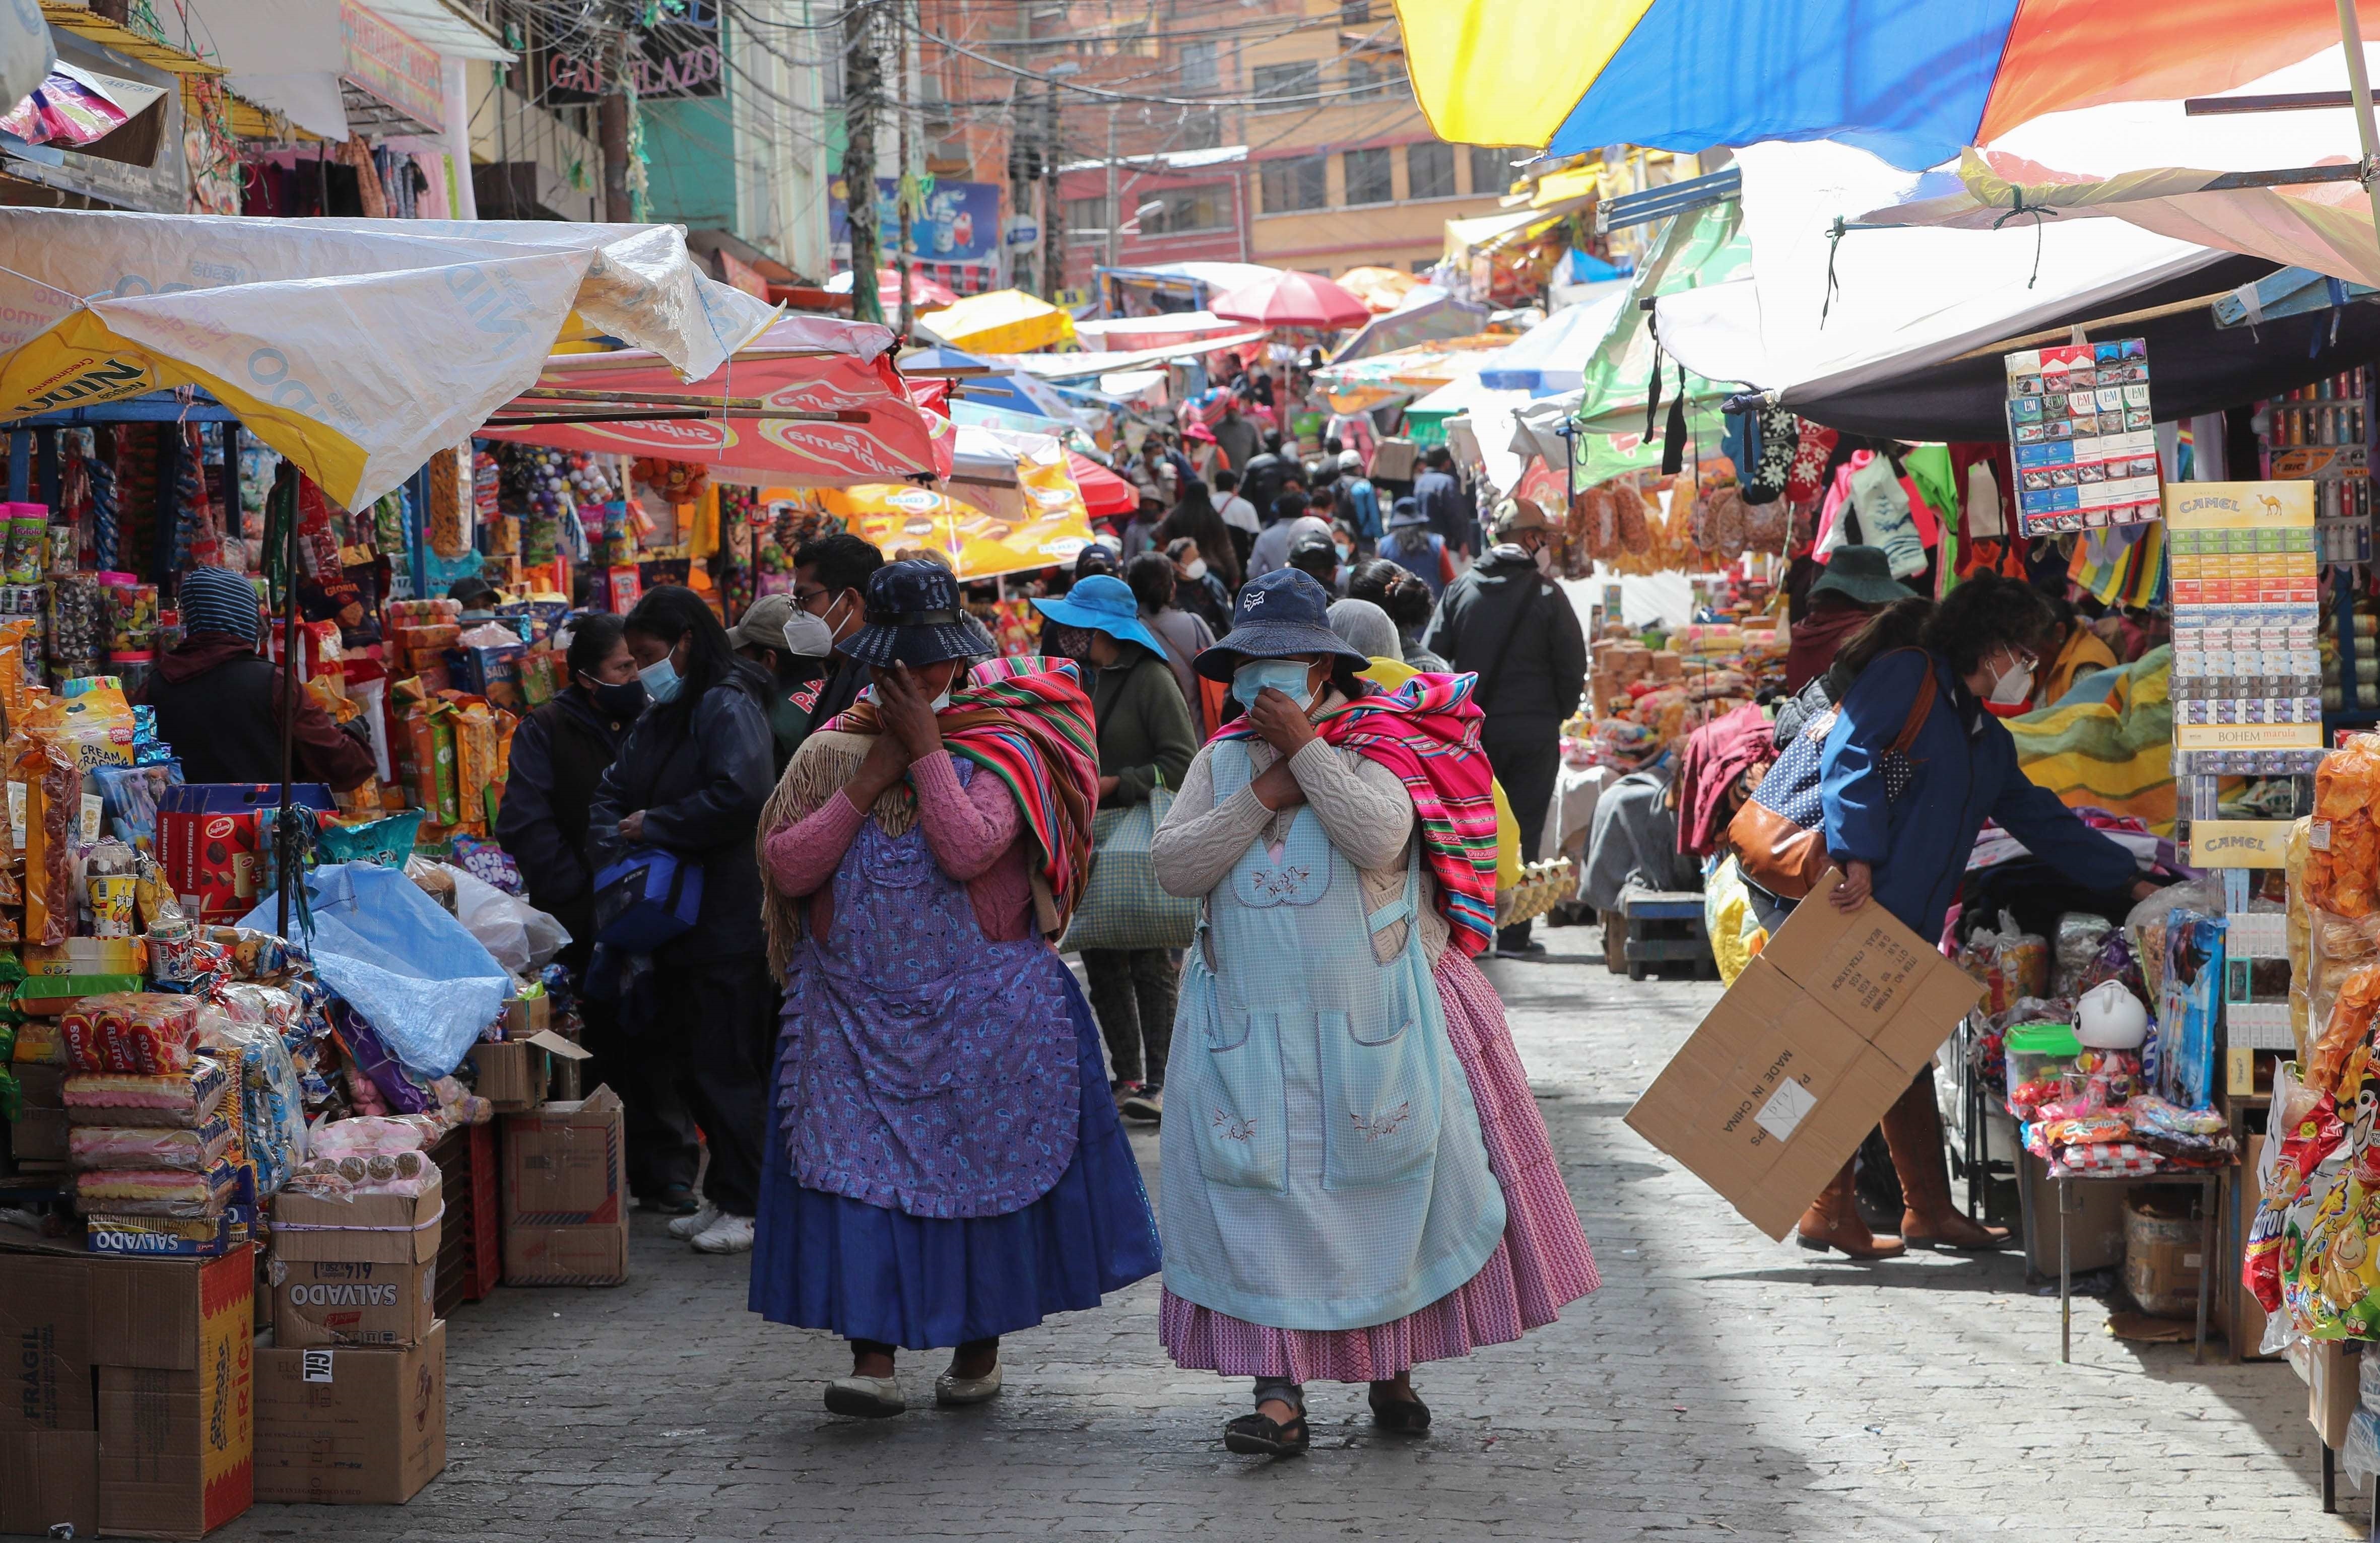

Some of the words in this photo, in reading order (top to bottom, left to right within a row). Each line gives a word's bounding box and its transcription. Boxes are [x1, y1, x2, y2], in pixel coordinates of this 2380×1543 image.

[27, 358, 94, 395] Crecimiento
[2077, 394, 2090, 406] L&M
[2104, 391, 2117, 402] L&M
[2132, 387, 2145, 399] L&M
[2283, 462, 2305, 471] BIC
[2179, 498, 2240, 513] CAMEL
[324, 582, 361, 597] GLORIA
[2179, 677, 2188, 685] LD
[2210, 677, 2218, 685] LD
[2240, 676, 2247, 685] LD
[2270, 675, 2278, 684] LD
[2179, 689, 2188, 697] LD
[2210, 688, 2218, 697] LD
[2240, 688, 2248, 697] LD
[2270, 687, 2278, 696] LD
[2300, 687, 2307, 695] LD
[2218, 731, 2260, 742] BOHEM
[2264, 728, 2295, 738] marula
[81, 745, 120, 762] CREAM
[209, 824, 230, 834] Suprema
[2205, 835, 2266, 853] CAMEL
[464, 851, 502, 872] OKA
[1902, 957, 1918, 973] ITEM
[1848, 972, 1862, 987] KGS
[1858, 979, 1871, 993] KGS
[1861, 986, 1880, 1008] BOXES
[1763, 1049, 1793, 1083] MADE
[1752, 1085, 1765, 1098] IN
[1723, 1101, 1752, 1132] CHINA
[96, 1232, 178, 1250] SALVADO
[289, 1284, 397, 1306] SALVADO
[18, 1327, 40, 1419] FRÁGIL
